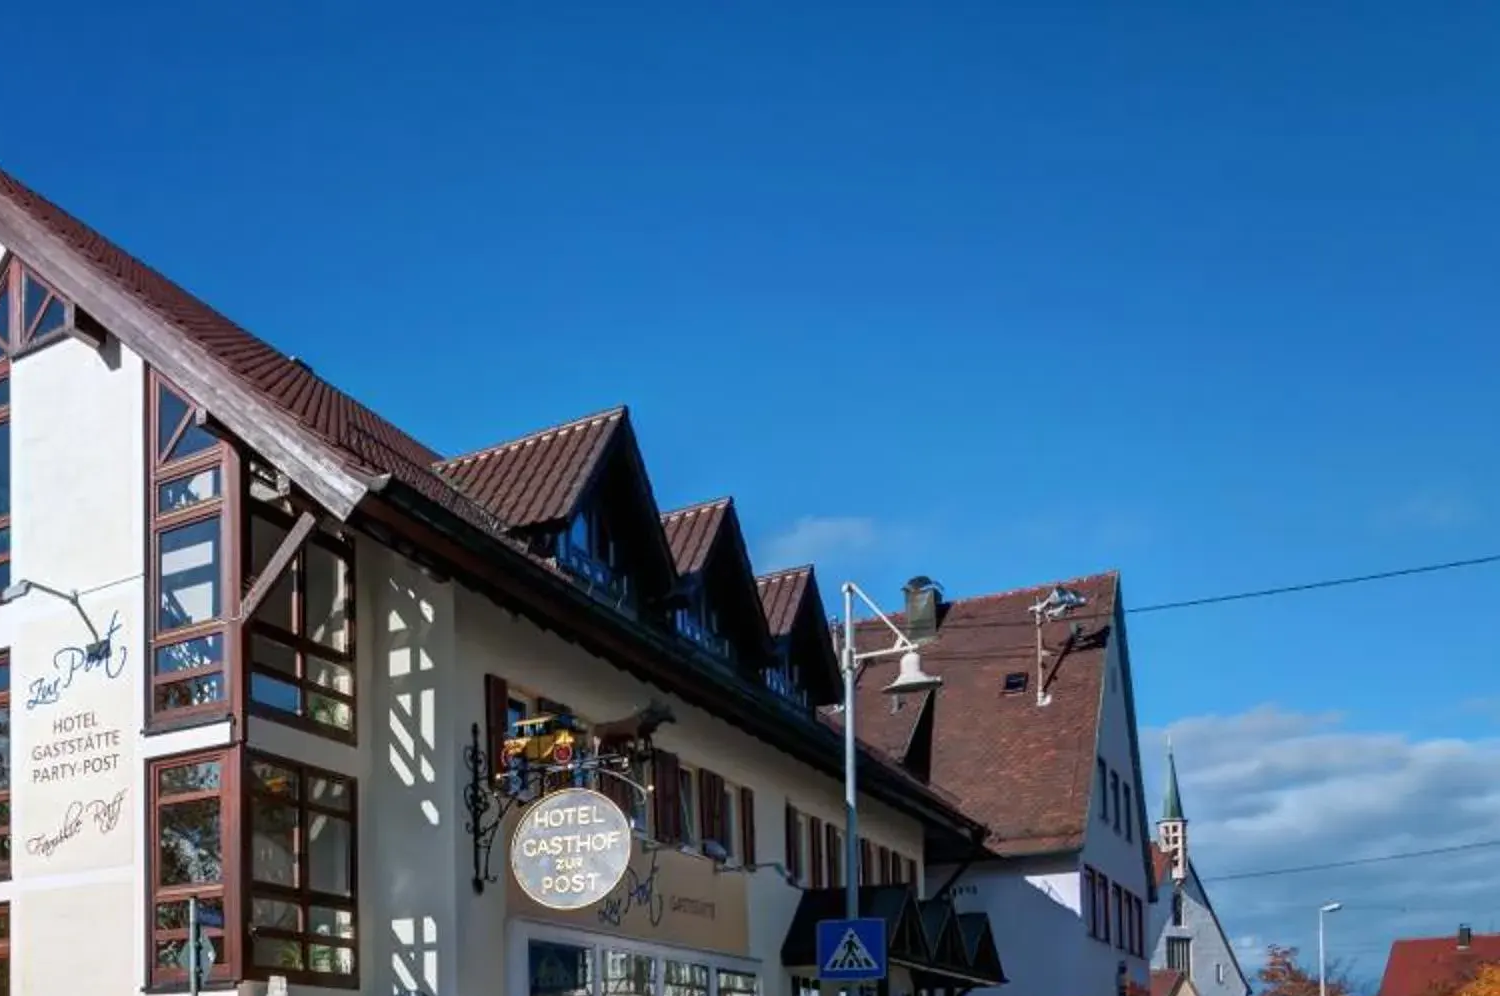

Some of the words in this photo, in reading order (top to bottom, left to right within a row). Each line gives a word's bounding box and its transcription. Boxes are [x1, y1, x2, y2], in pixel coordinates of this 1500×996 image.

[52, 711, 98, 733] HOTEL
[32, 729, 120, 761] GASTSTÄTTE
[32, 753, 120, 783] PARTY-POST
[534, 805, 605, 828] HOTEL
[522, 831, 620, 857] GASTHOF
[555, 857, 584, 870] ZUR
[541, 872, 601, 894] POST
